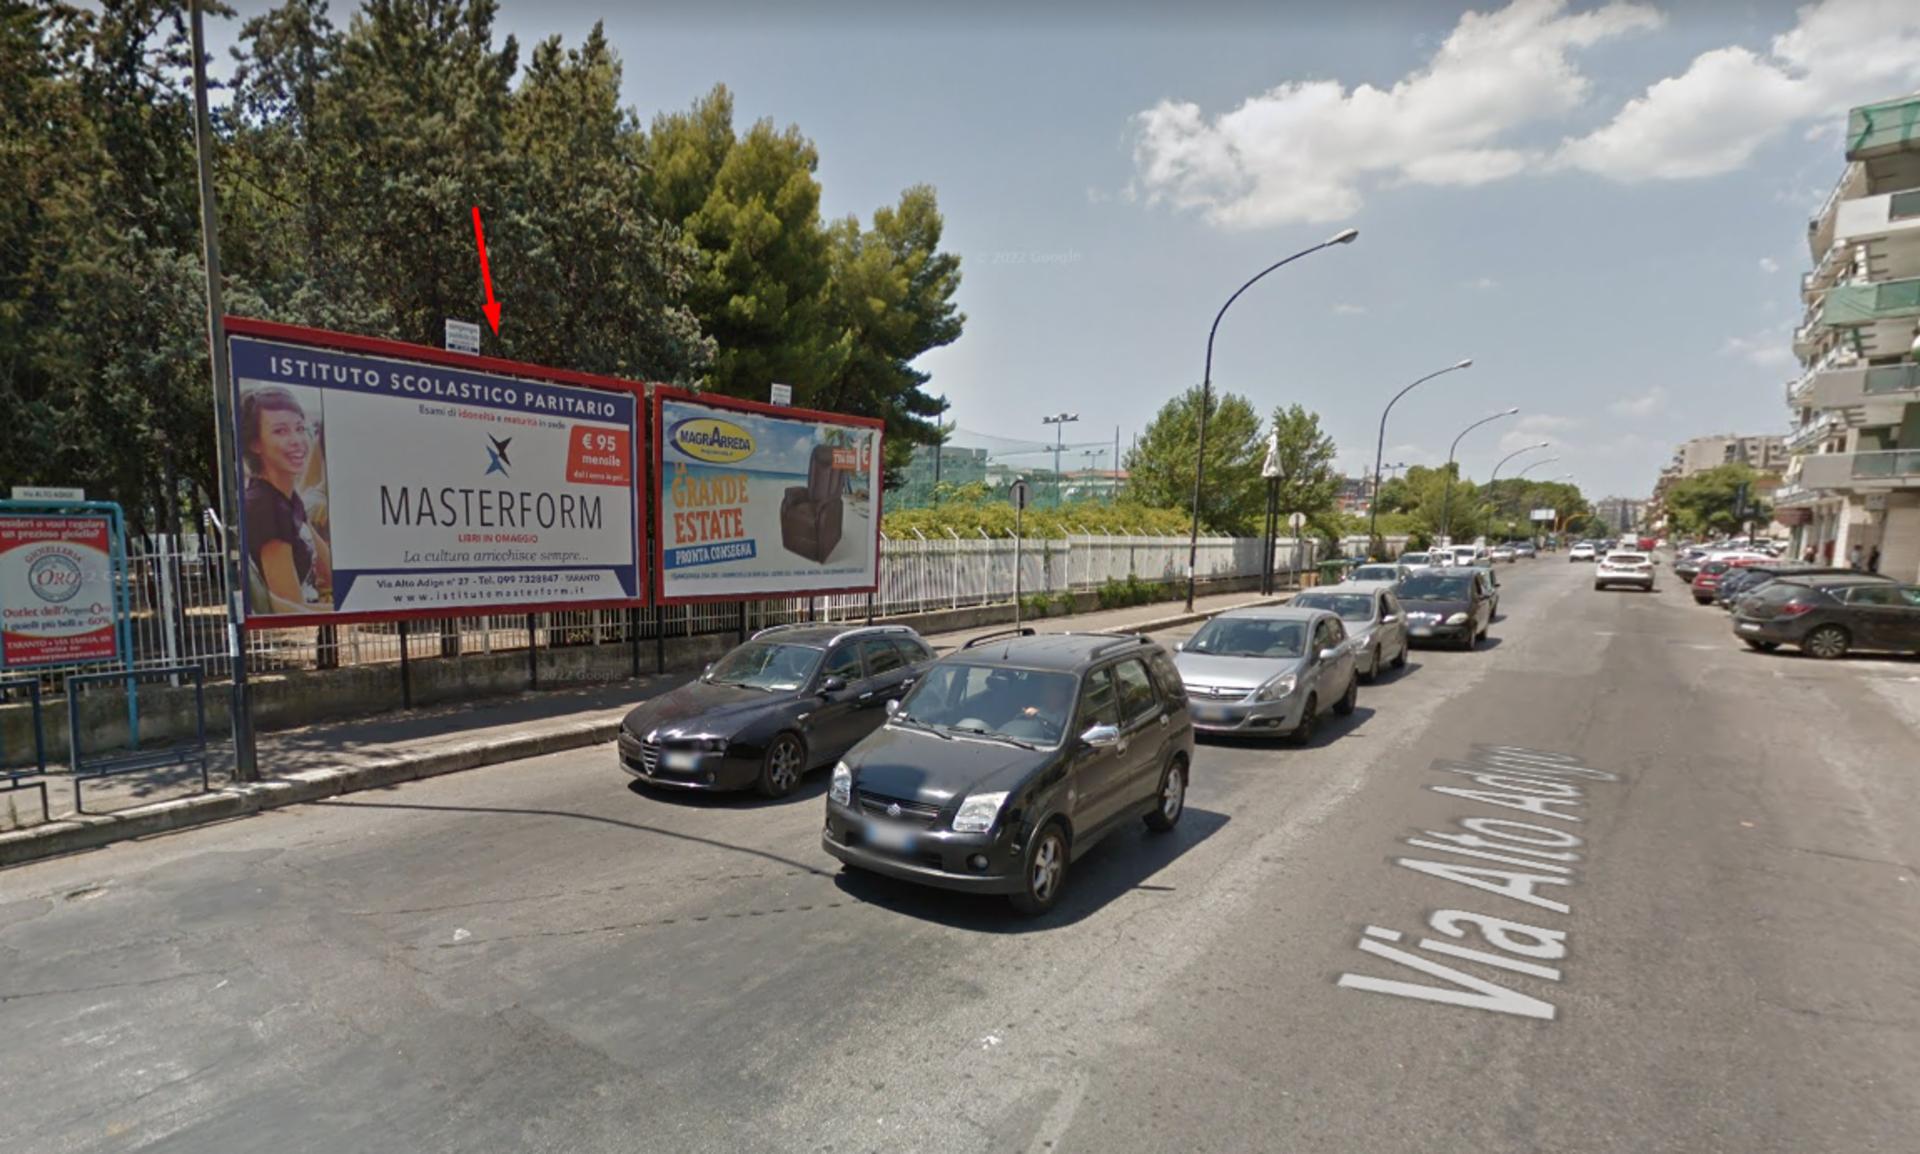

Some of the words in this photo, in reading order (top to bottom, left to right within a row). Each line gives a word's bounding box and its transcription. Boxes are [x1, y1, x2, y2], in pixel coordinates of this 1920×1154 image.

[270, 356, 380, 387] ISTITUTO
[390, 373, 518, 405] SCOLASTICO
[524, 392, 616, 417] PARITARIO
[418, 404, 446, 416] Esami
[447, 408, 457, 418] di
[539, 419, 546, 428] in
[582, 433, 592, 450] €
[597, 435, 616, 451] 95
[582, 454, 621, 467] mensile
[671, 473, 749, 509] GRANDE
[380, 485, 602, 529] MASTERFORM
[674, 509, 744, 543] ESTATE
[458, 534, 481, 543] LIBRI
[483, 534, 493, 543] IN
[495, 534, 538, 544] OMAGGIO
[403, 550, 421, 563] La
[424, 550, 470, 562] cultura
[675, 547, 710, 565] PRONTA
[710, 542, 752, 561] CONSEGNA
[376, 579, 393, 589] Via
[394, 579, 414, 588] Alto
[417, 578, 444, 588] Adige
[478, 575, 495, 585] Tel.
